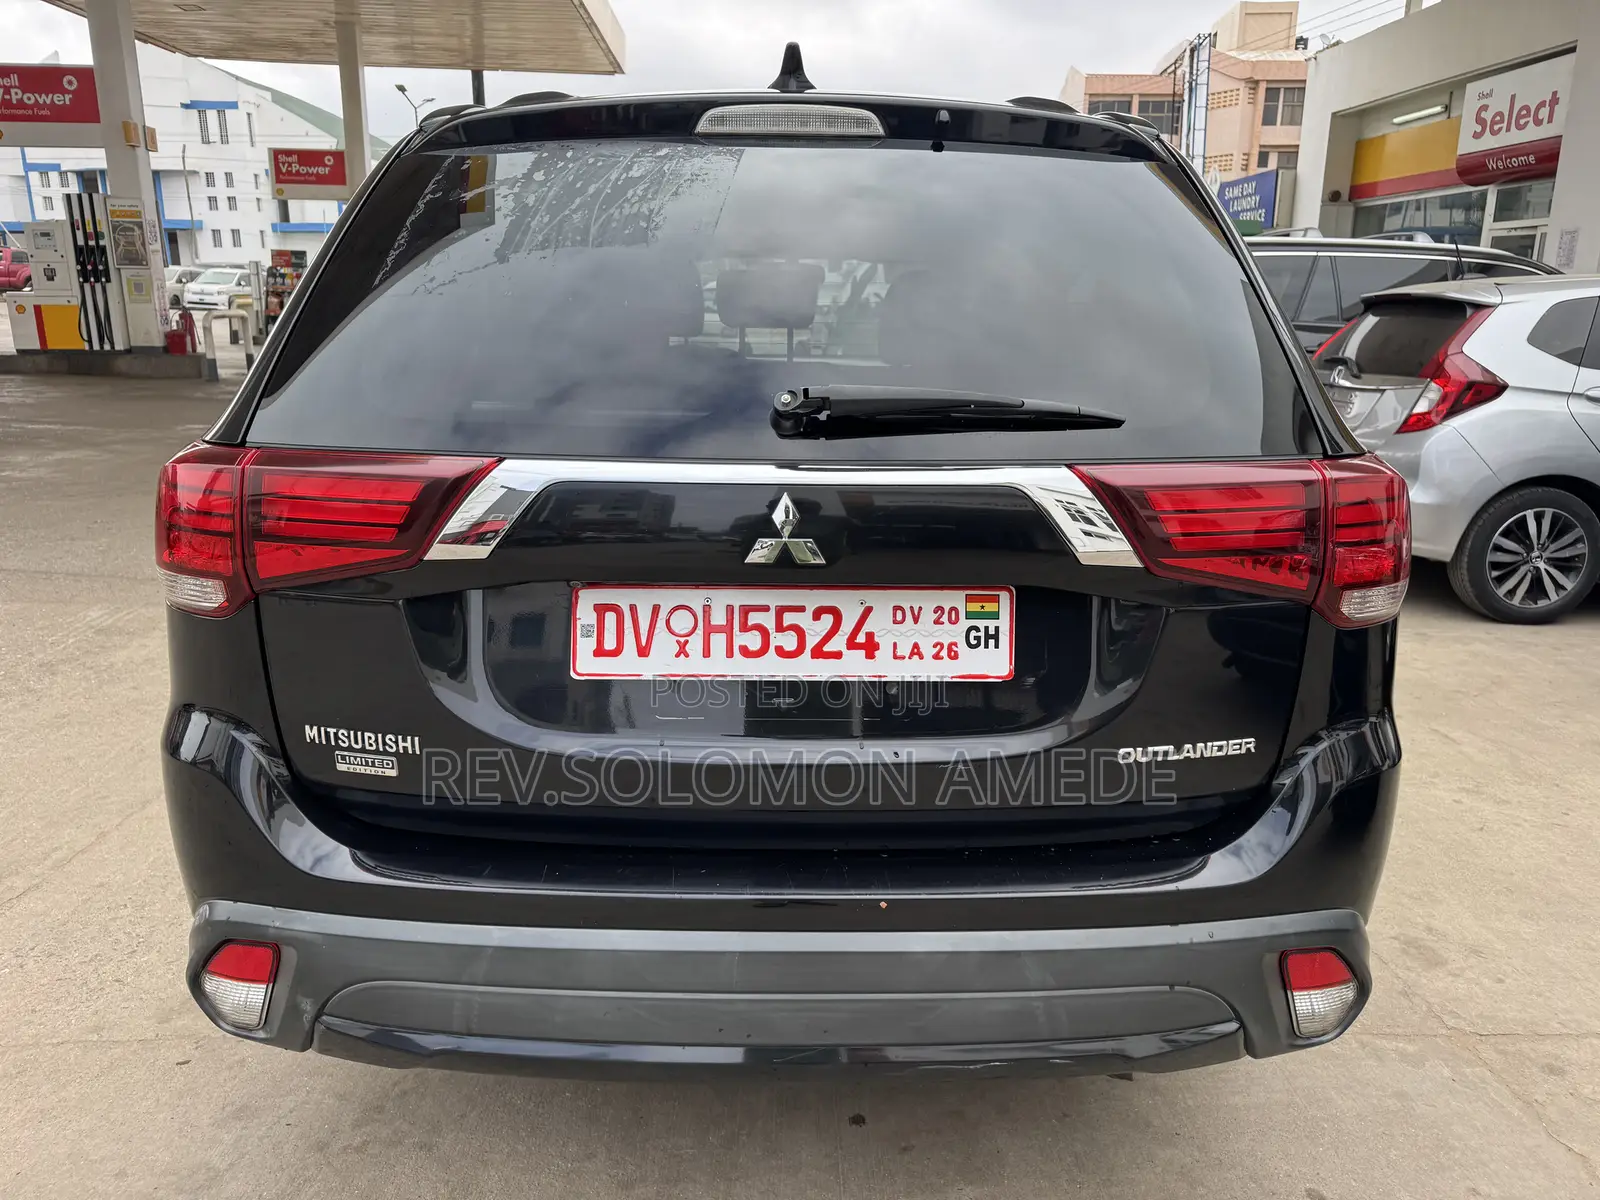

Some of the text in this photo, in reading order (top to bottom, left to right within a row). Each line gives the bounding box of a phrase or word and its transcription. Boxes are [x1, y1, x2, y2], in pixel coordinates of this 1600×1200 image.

[0, 88, 72, 105] -Power
[1477, 88, 1494, 101] Shell
[1471, 90, 1560, 140] Select
[278, 154, 298, 163] Shell
[1485, 154, 1536, 171] Welcome
[279, 162, 331, 175] V-Power
[1224, 180, 1257, 200] SAME DAY
[1229, 194, 1260, 213] LAUNDRY
[1239, 208, 1266, 222] SERVICE
[892, 605, 960, 625] DV 20
[593, 603, 662, 658] DV
[702, 604, 880, 660] H5524
[965, 625, 1000, 650] GH
[892, 641, 960, 660] LA 26
[304, 724, 421, 755] MITSUBISHI
[1117, 737, 1256, 764] OUTLANDER
[337, 755, 393, 769] LIMITED
[346, 766, 386, 775] EDITION
